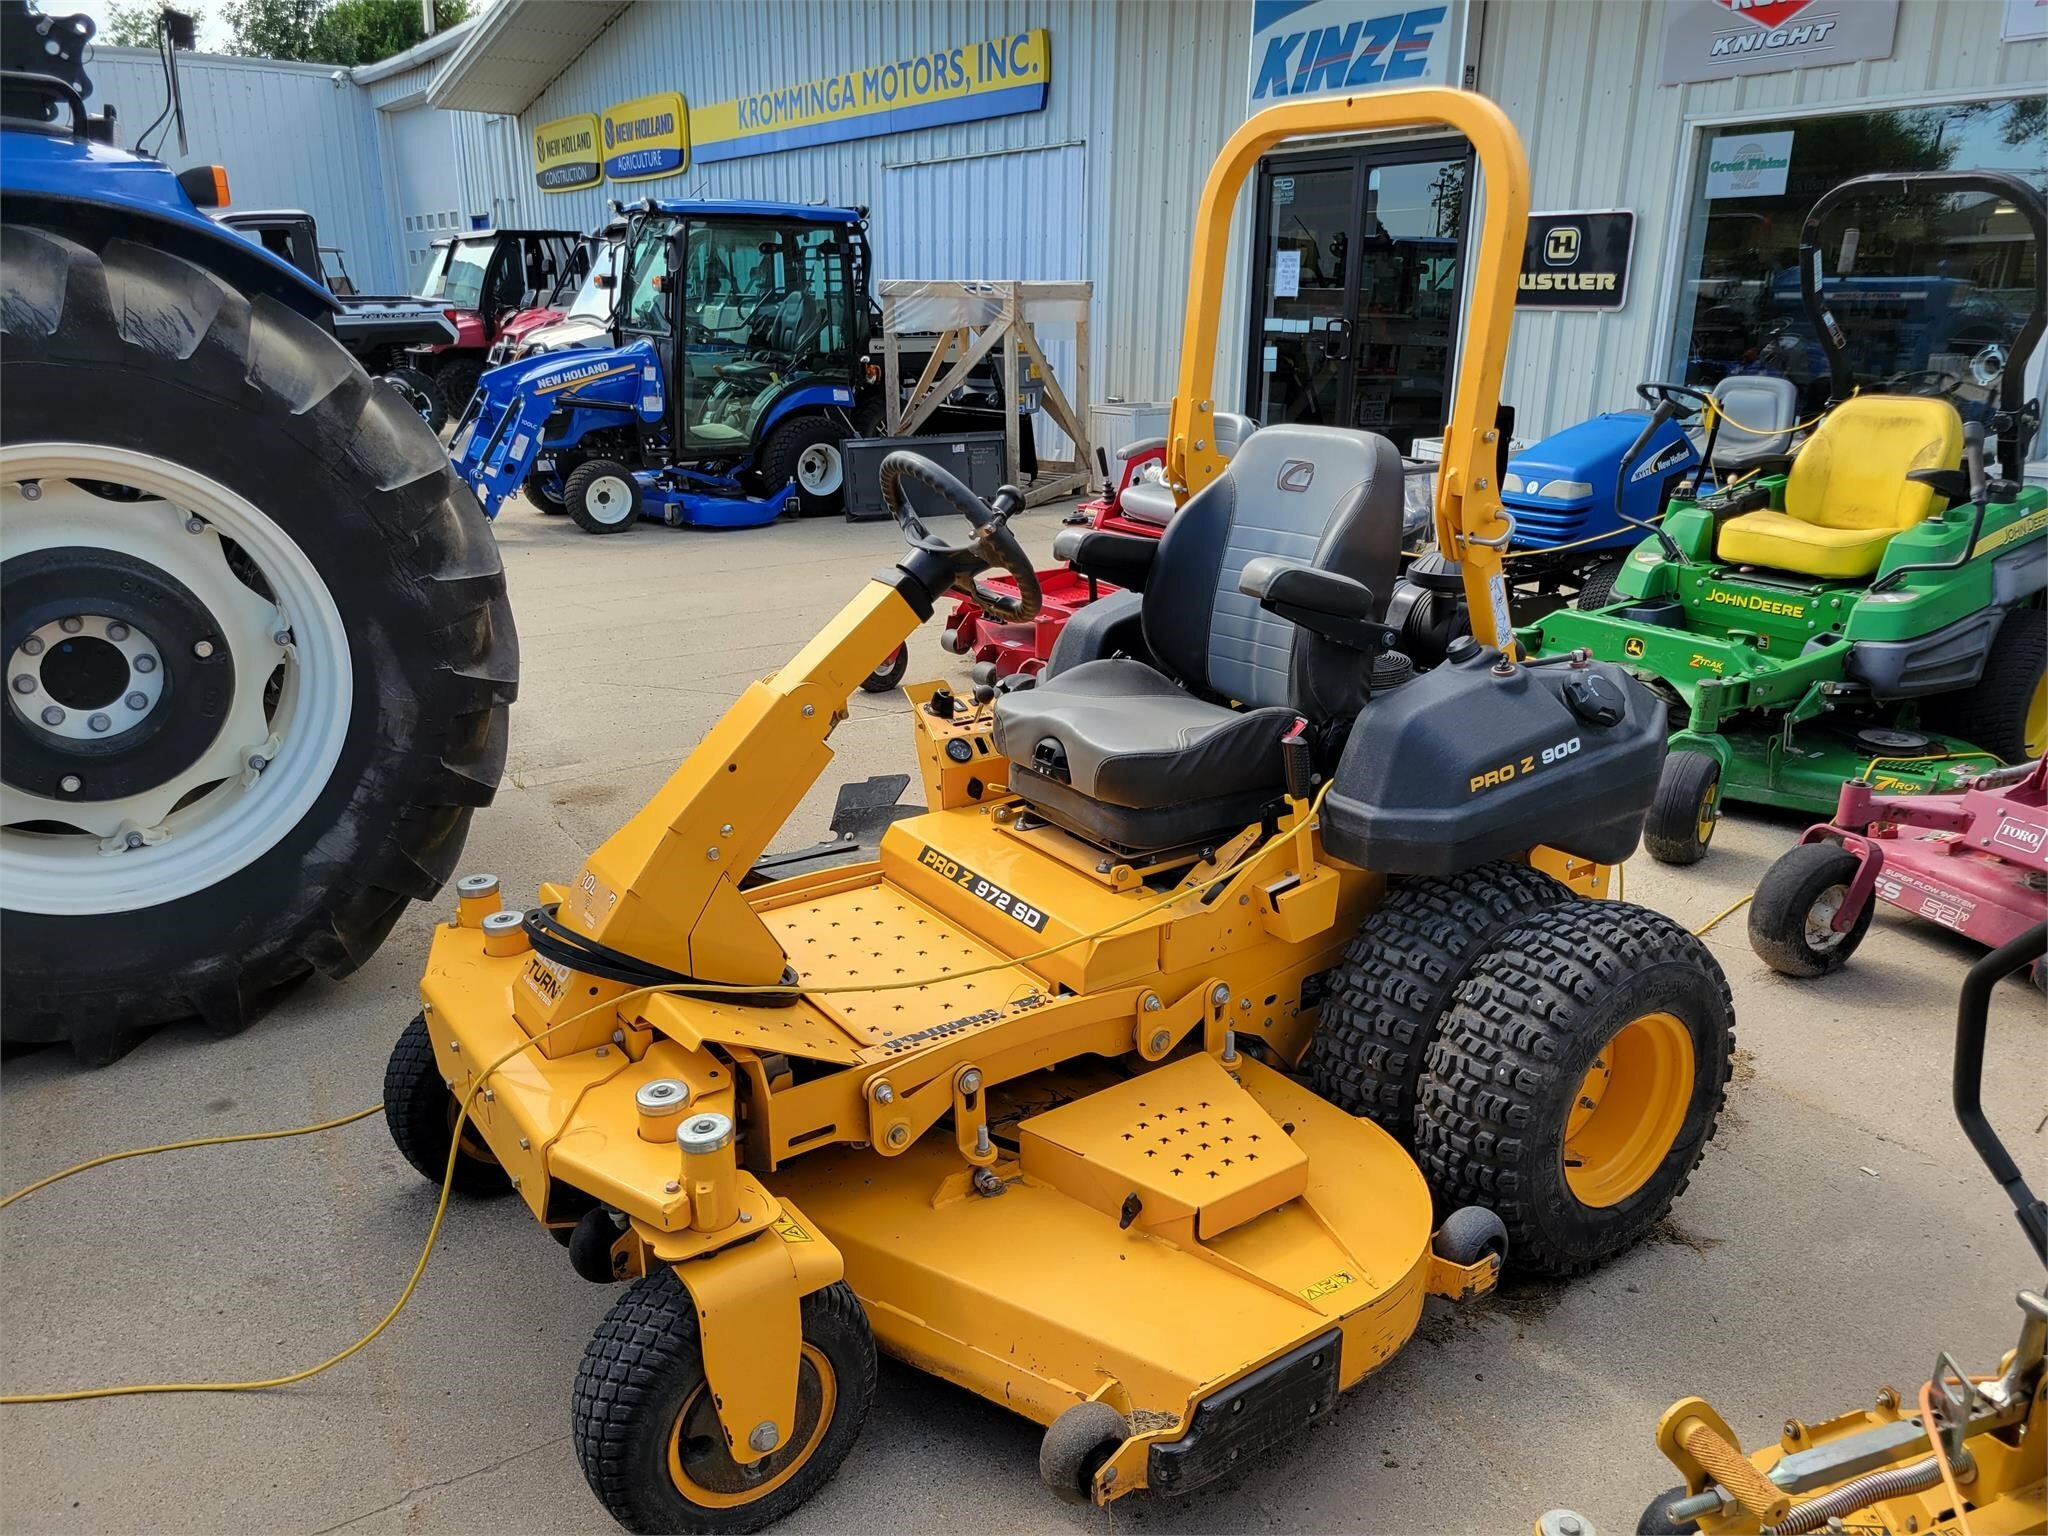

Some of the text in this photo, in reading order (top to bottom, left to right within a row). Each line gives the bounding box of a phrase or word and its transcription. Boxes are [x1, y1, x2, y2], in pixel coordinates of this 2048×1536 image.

[1252, 6, 1447, 99] KINZE
[1710, 22, 1836, 56] KNIGHT
[737, 33, 1039, 130] KROMMINGA MOTORS, INC.
[615, 112, 674, 144] NEW HOLLAND
[545, 131, 592, 157] NEW HOLLAND
[617, 150, 662, 171] AGRICULTURE
[1710, 157, 1788, 173] Great Plains
[545, 166, 587, 186] CONSTRUCTION
[1519, 273, 1616, 290] USTLER
[536, 374, 563, 389] NEW
[562, 362, 609, 385] HOLLAND
[1657, 448, 1690, 471] New Holland
[2004, 523, 2028, 545] JOHN
[1705, 589, 1804, 618] JOHN DEERE
[1470, 737, 1581, 793] PRO Z 900
[2002, 824, 2038, 844] TORO
[923, 849, 1041, 928] PRO Z 972 SD
[1885, 868, 1977, 910] SUPER FLOW SYSTEM
[528, 958, 557, 999] TURN
